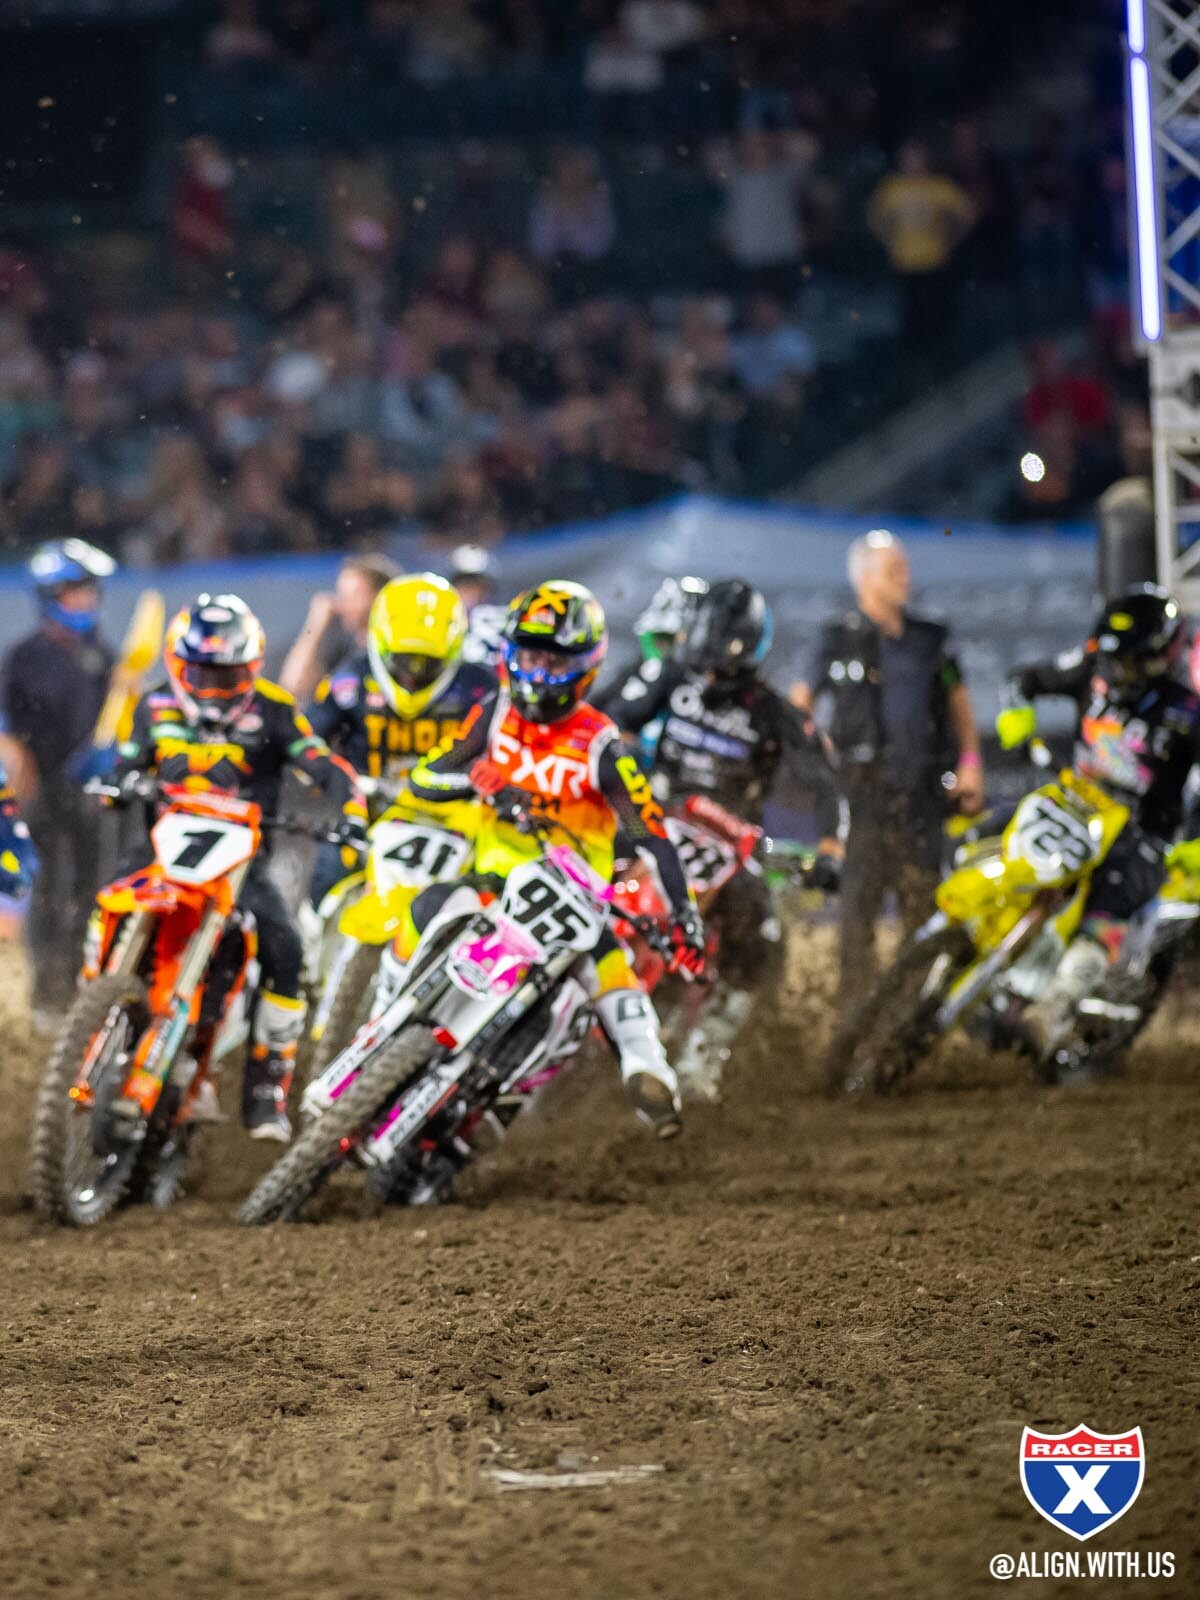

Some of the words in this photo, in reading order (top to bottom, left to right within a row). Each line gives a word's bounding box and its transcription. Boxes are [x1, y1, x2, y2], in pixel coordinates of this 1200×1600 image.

[172, 830, 227, 869] 1
[384, 836, 456, 876] 41
[513, 878, 590, 945] 95
